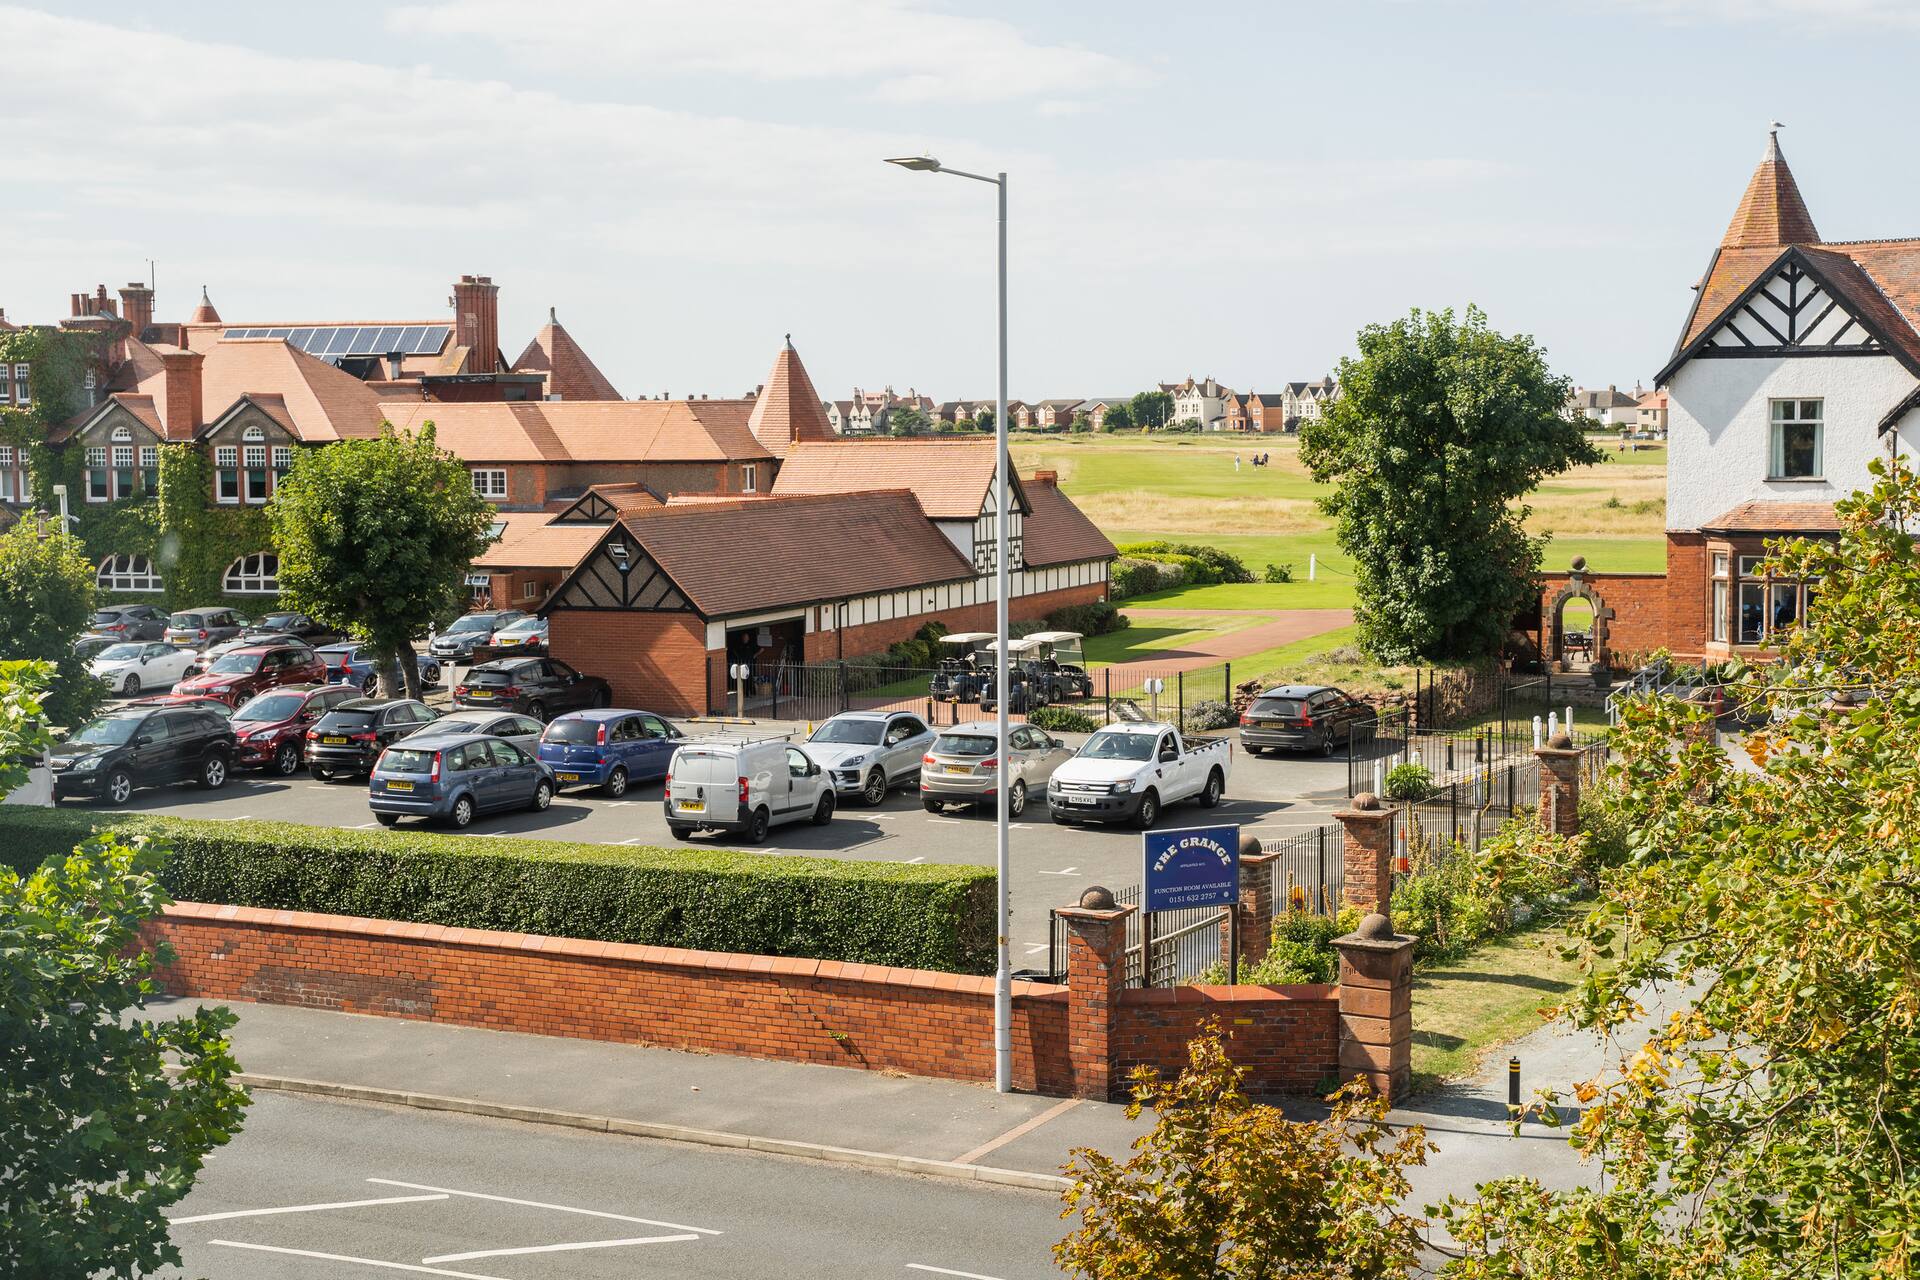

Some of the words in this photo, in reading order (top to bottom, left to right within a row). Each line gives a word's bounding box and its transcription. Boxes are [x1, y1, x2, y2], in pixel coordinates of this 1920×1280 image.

[1153, 845, 1178, 872] THE
[1180, 837, 1232, 865] GRANGE
[1201, 881, 1232, 889] AVAILABLE
[1169, 896, 1185, 904] 0151
[1186, 894, 1199, 902] 632
[1200, 892, 1217, 900] 2757
